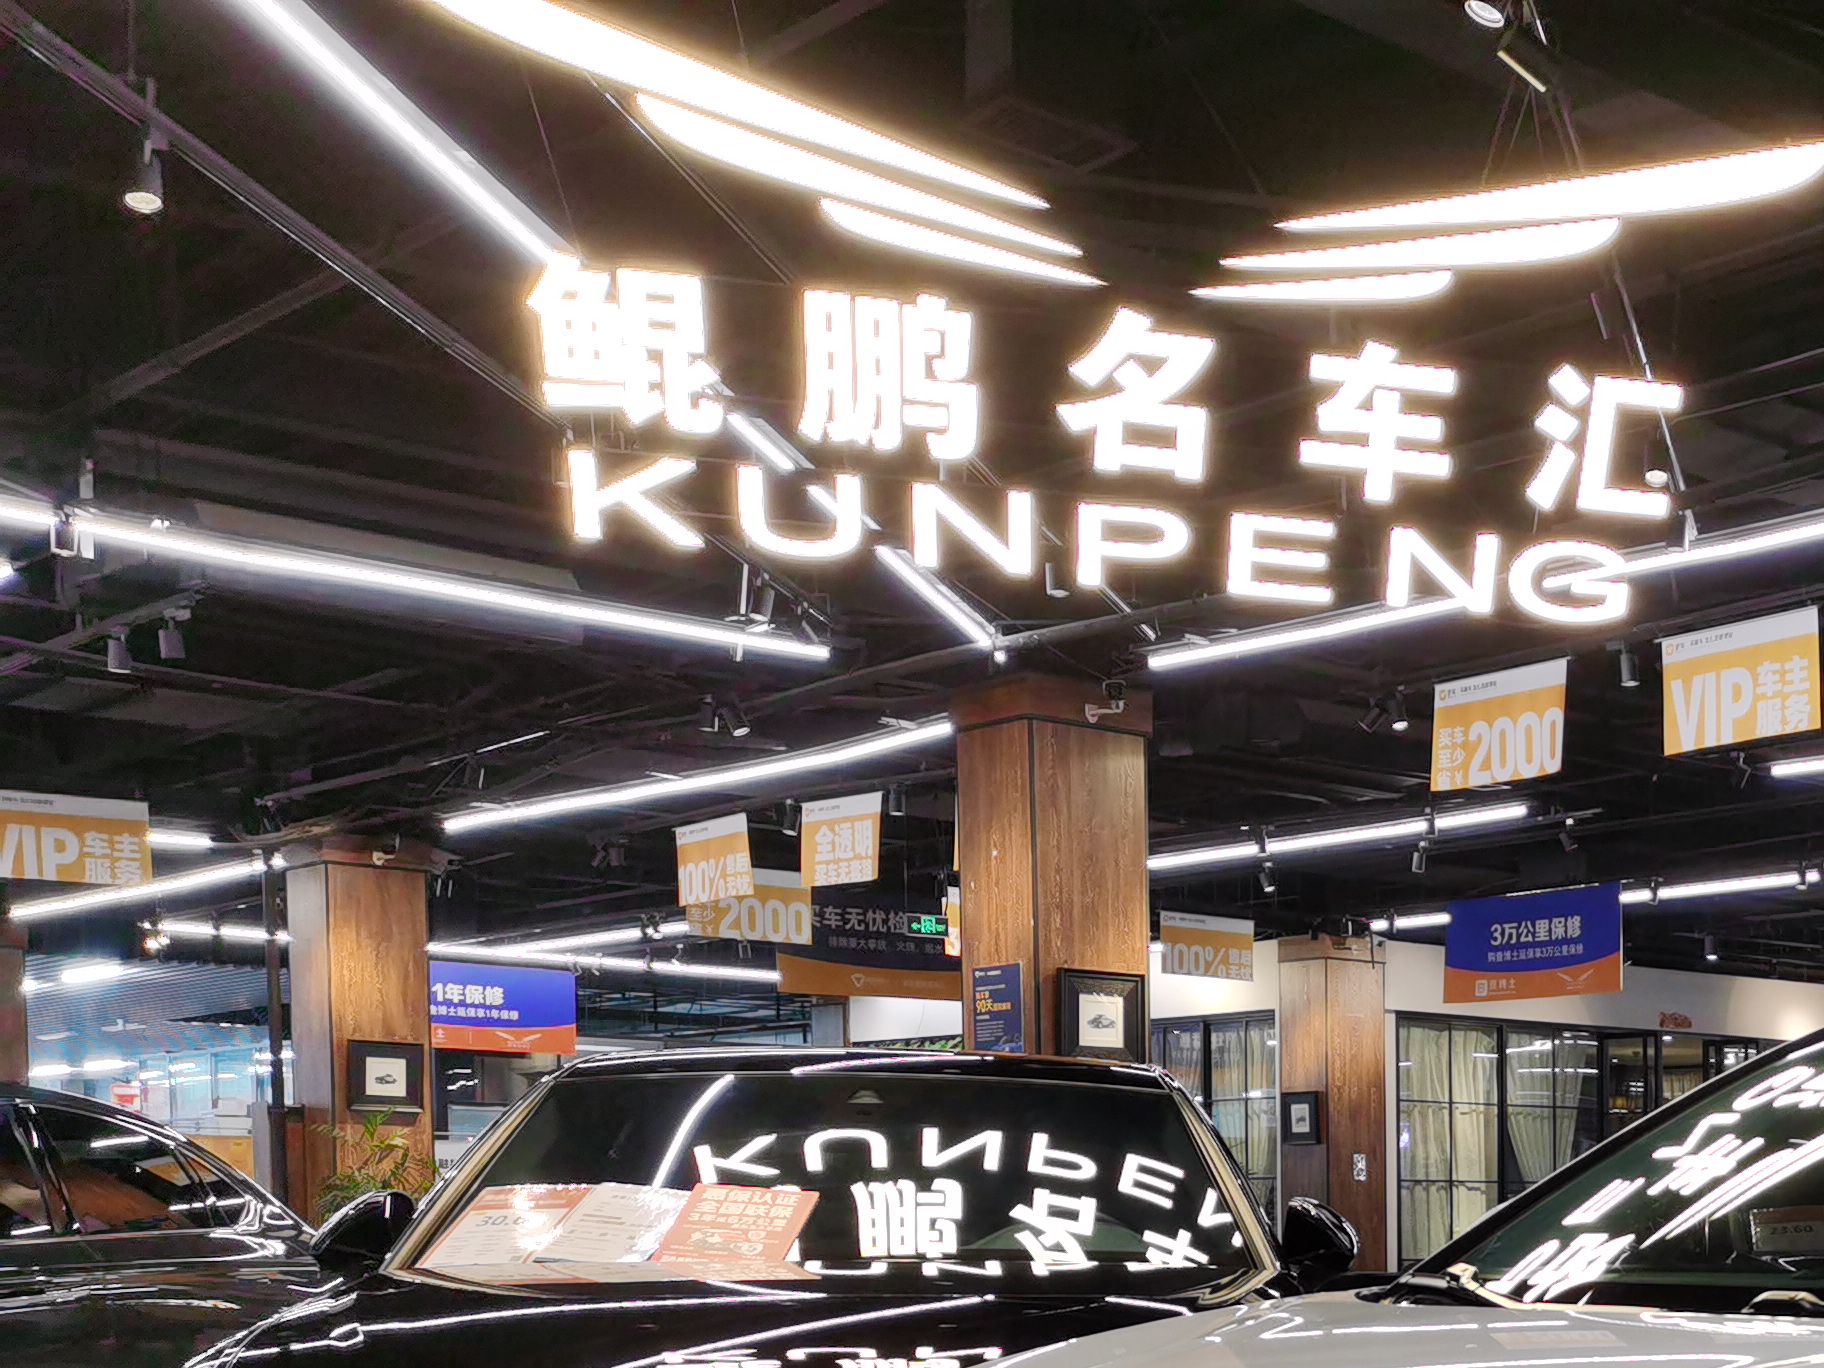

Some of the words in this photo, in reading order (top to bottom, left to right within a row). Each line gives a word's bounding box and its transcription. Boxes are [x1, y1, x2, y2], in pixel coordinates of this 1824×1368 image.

[527, 264, 1685, 519] 鲲鹏名车汇
[568, 448, 1631, 624] KUNPENG
[1755, 655, 1811, 697] 车主
[1670, 667, 1754, 753] VIP
[1755, 694, 1812, 736] 服务
[1468, 706, 1565, 787] 2000
[82, 830, 142, 859] 车主
[814, 819, 873, 862] 全透明
[84, 857, 142, 885] 服务
[678, 857, 725, 906] 100%
[717, 897, 810, 943] 2000
[1489, 915, 1582, 946] 3万公里保修
[1162, 942, 1227, 978] 100%
